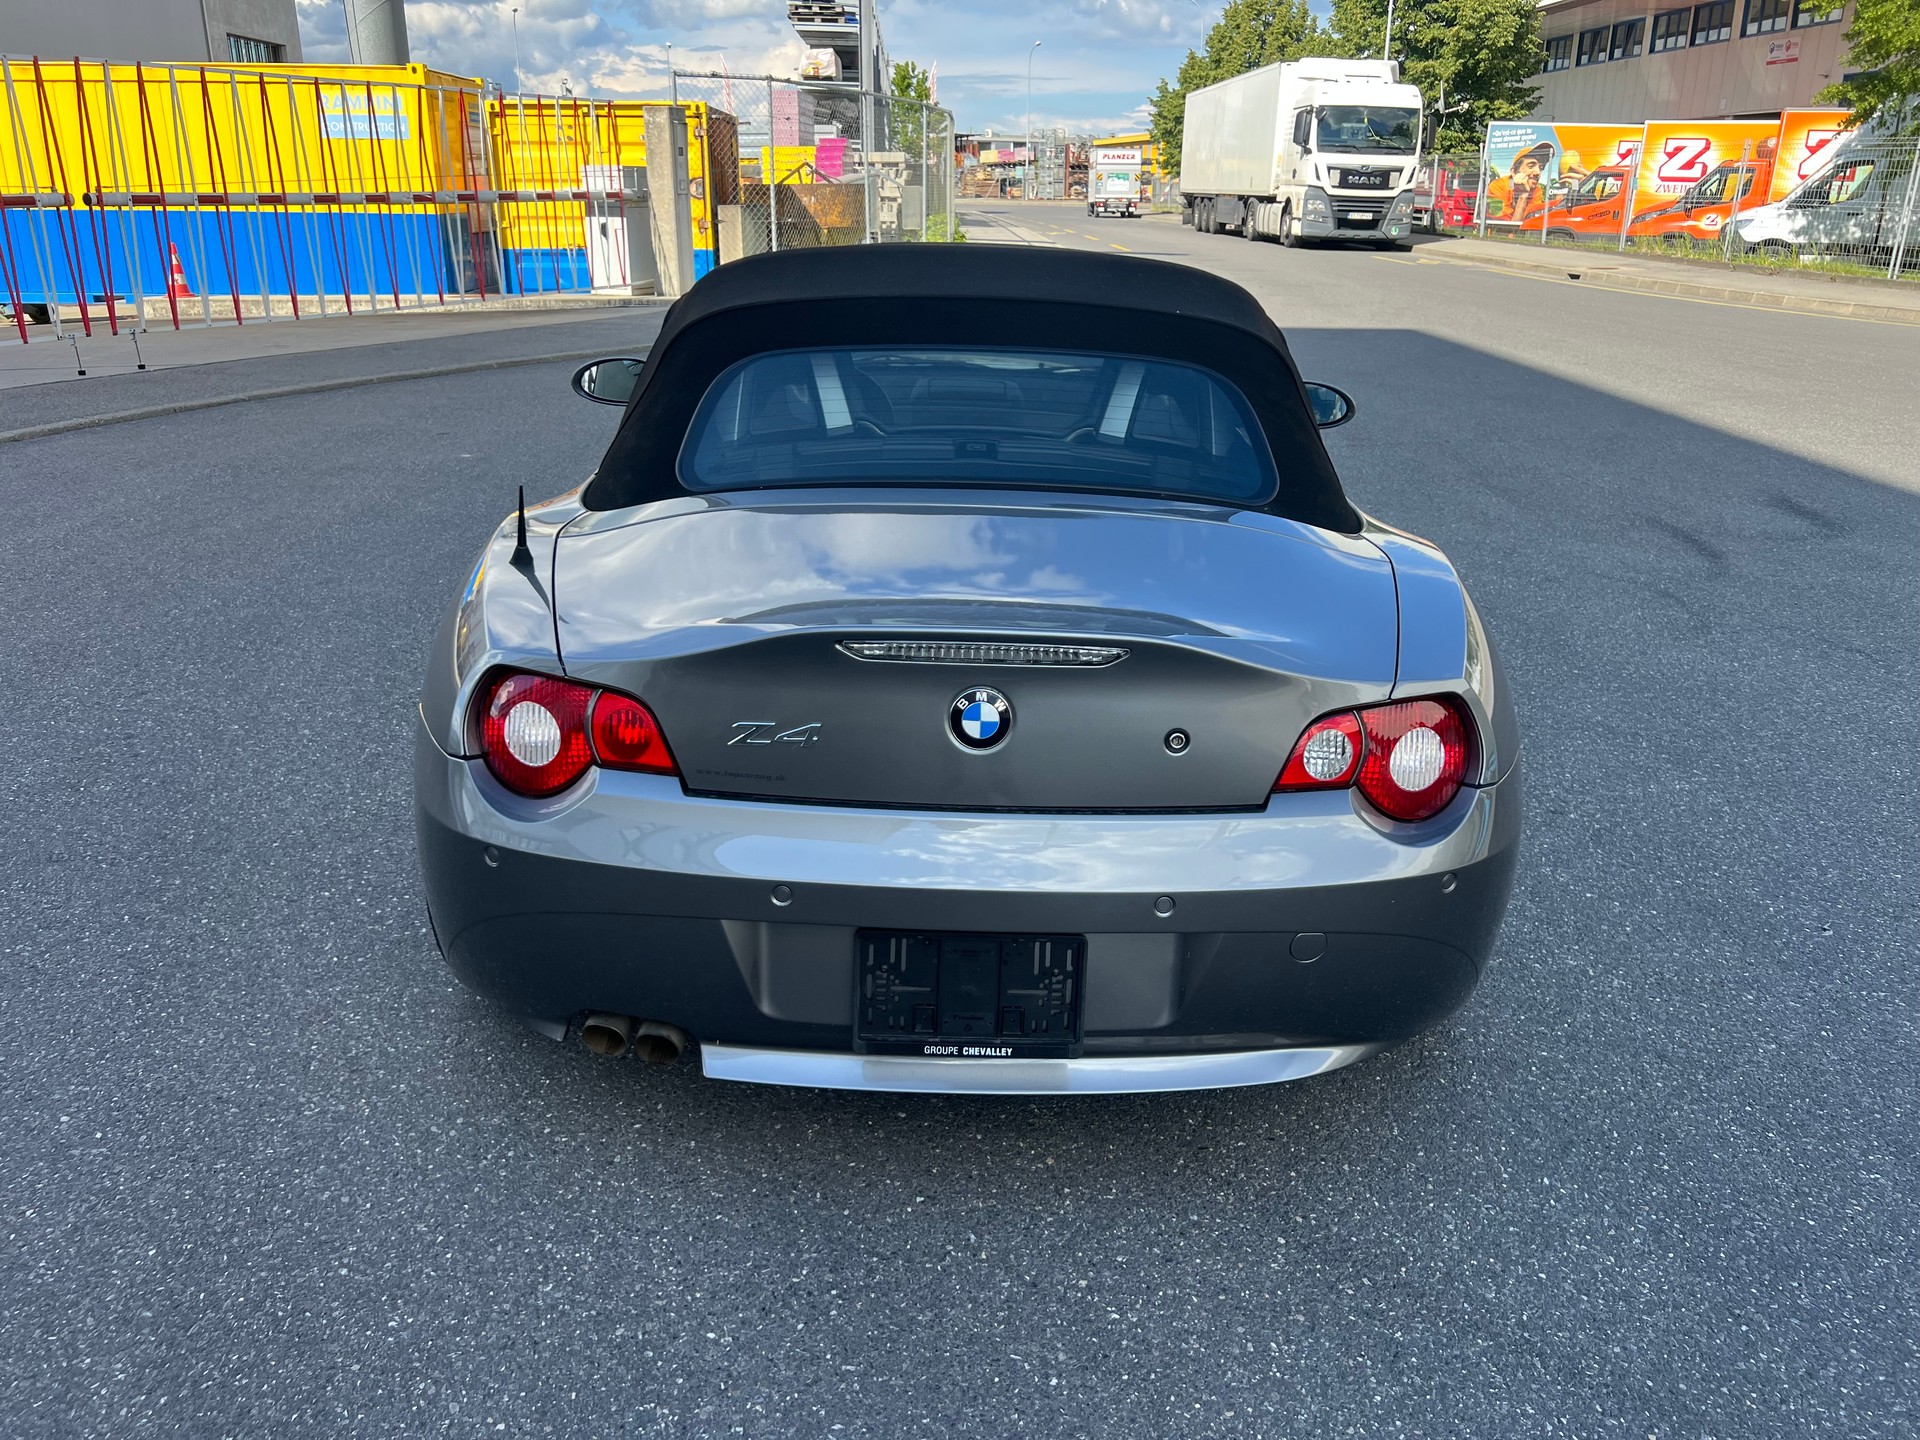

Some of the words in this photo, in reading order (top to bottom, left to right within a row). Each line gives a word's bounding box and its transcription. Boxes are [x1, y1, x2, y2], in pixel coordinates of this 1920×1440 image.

[1658, 138, 1711, 182] Z
[1347, 175, 1382, 185] MAN
[956, 691, 1007, 712] BMW
[727, 721, 822, 748] Z4
[924, 1045, 959, 1056] GROUPE
[962, 1046, 1013, 1057] CHEVALLEY
